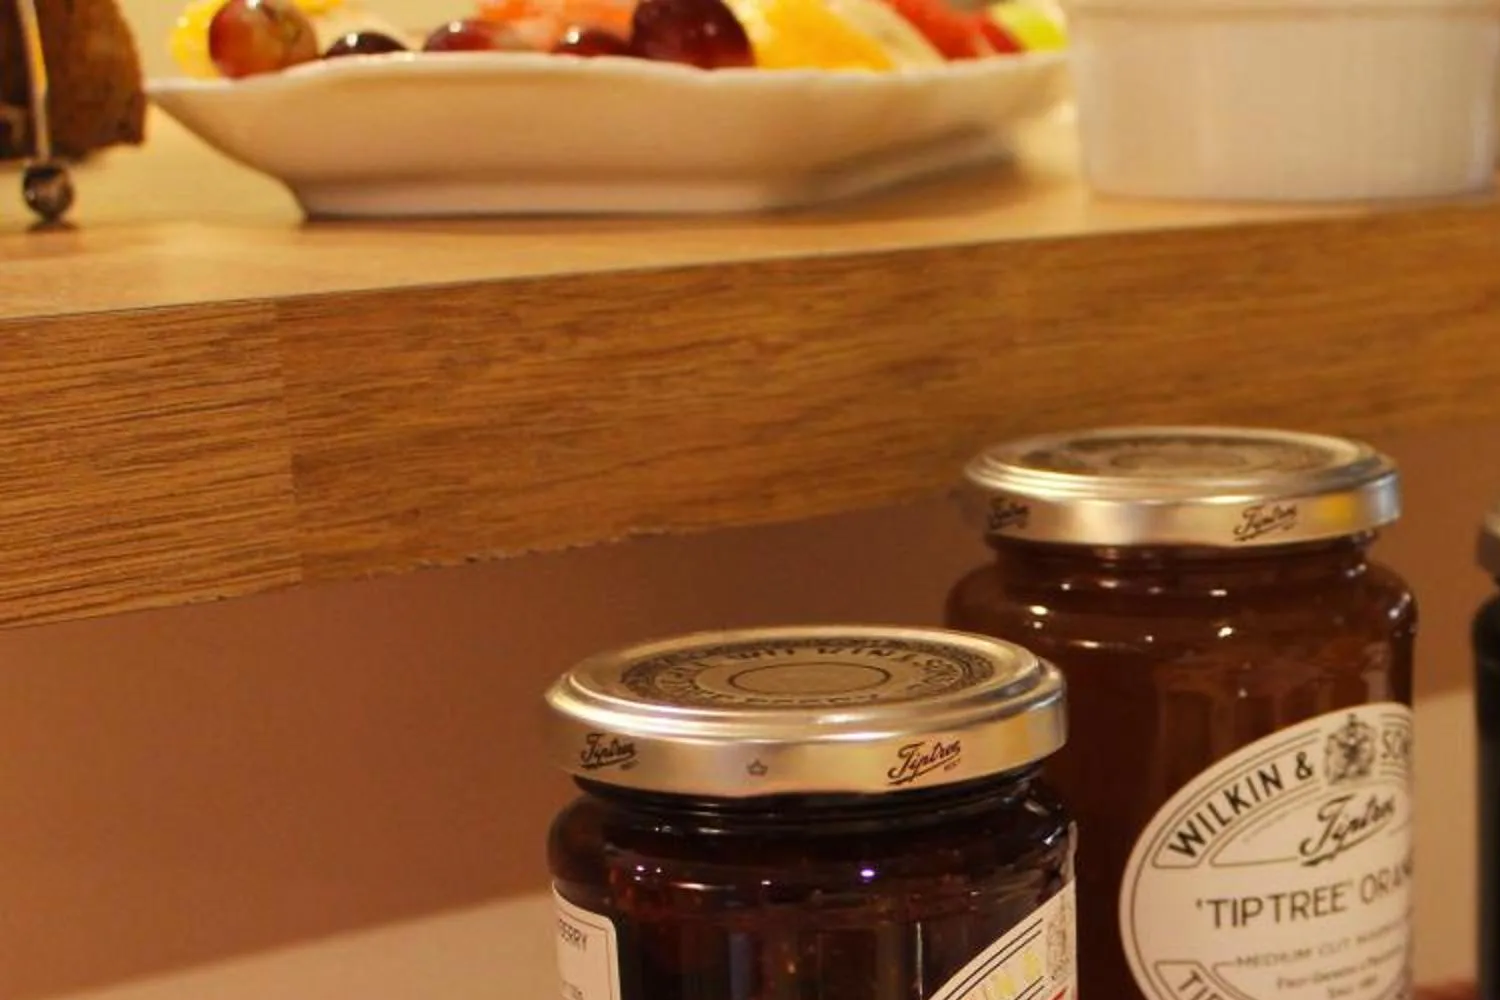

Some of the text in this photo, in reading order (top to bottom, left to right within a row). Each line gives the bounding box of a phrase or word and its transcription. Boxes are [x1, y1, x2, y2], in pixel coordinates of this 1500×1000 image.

[887, 740, 961, 786] Tiptree
[1168, 763, 1284, 861] WILKIN
[1295, 751, 1315, 781] &
[1299, 794, 1397, 867] Tiptree
